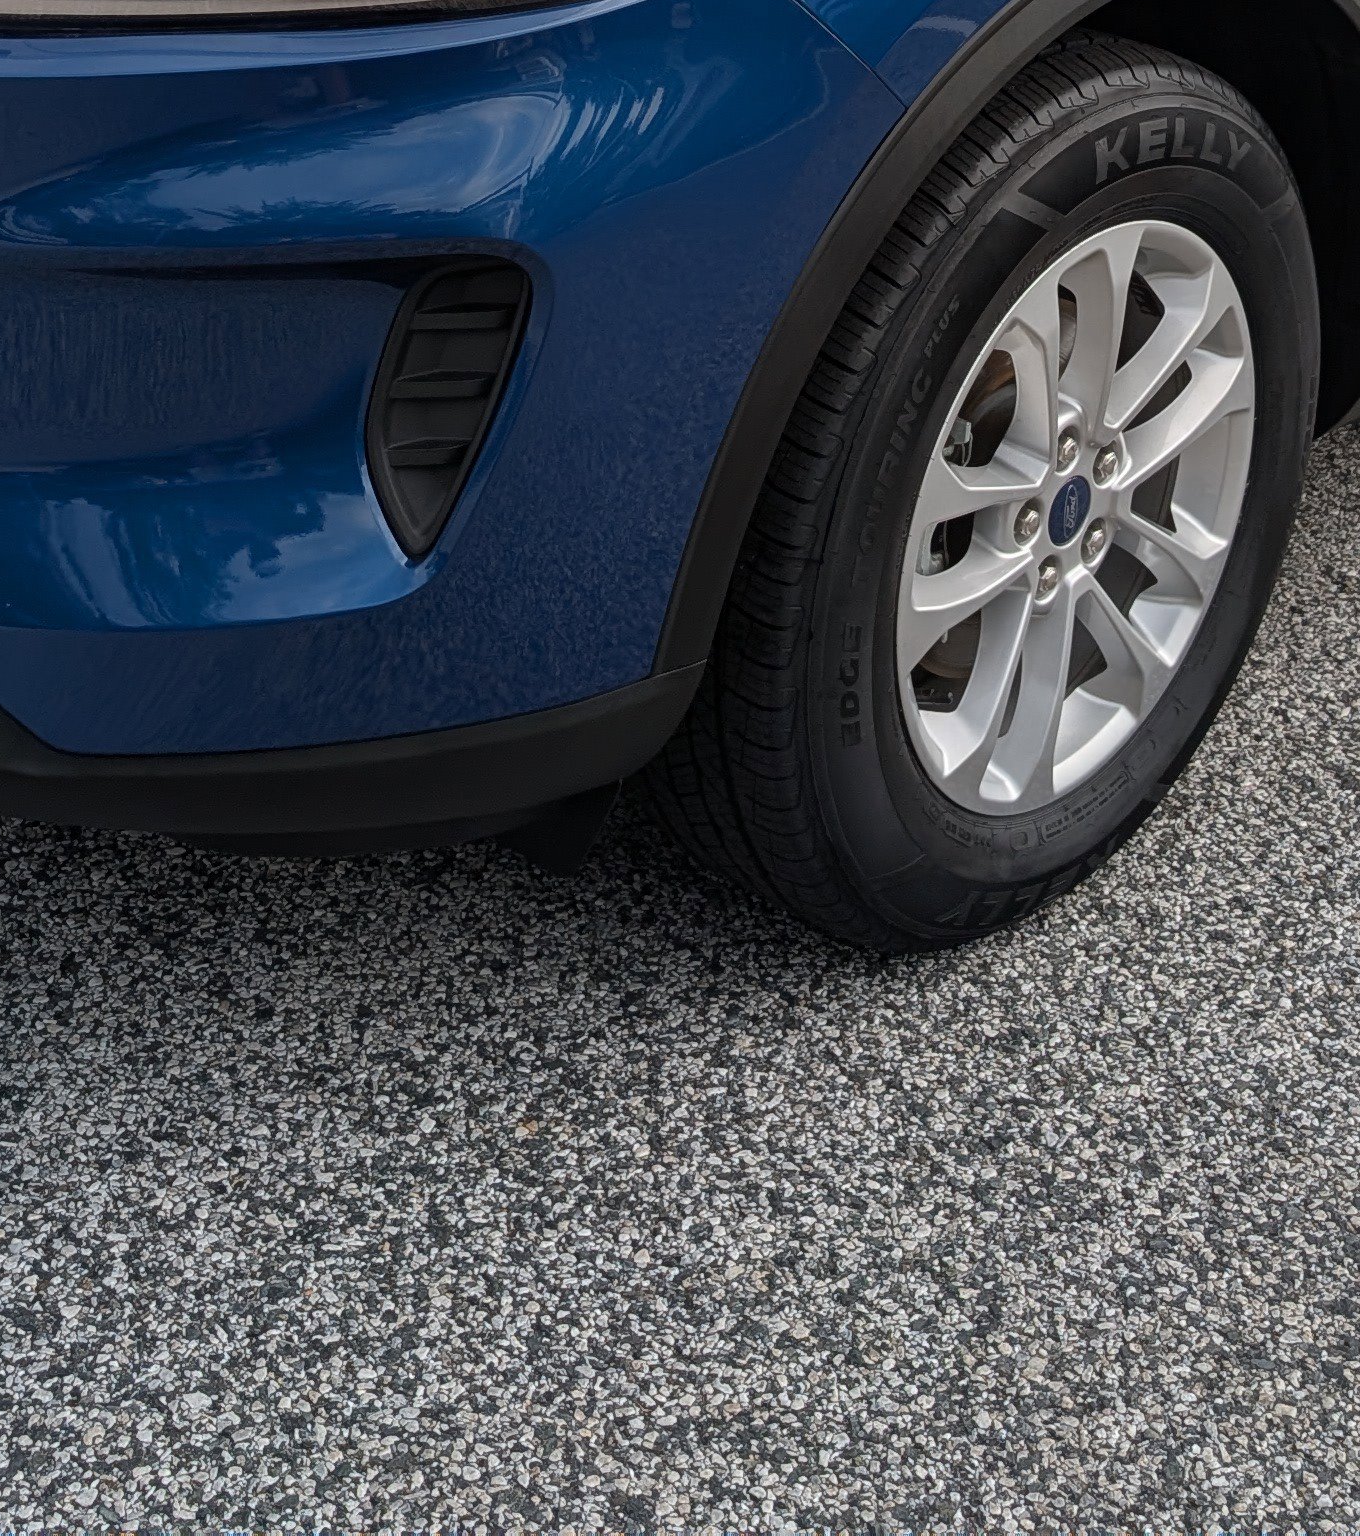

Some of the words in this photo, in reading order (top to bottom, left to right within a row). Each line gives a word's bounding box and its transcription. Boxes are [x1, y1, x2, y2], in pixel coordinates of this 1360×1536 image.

[1093, 115, 1252, 186] KELLY
[924, 293, 960, 359] PLUS
[851, 367, 933, 589] TOURING
[840, 622, 864, 748] EDGE
